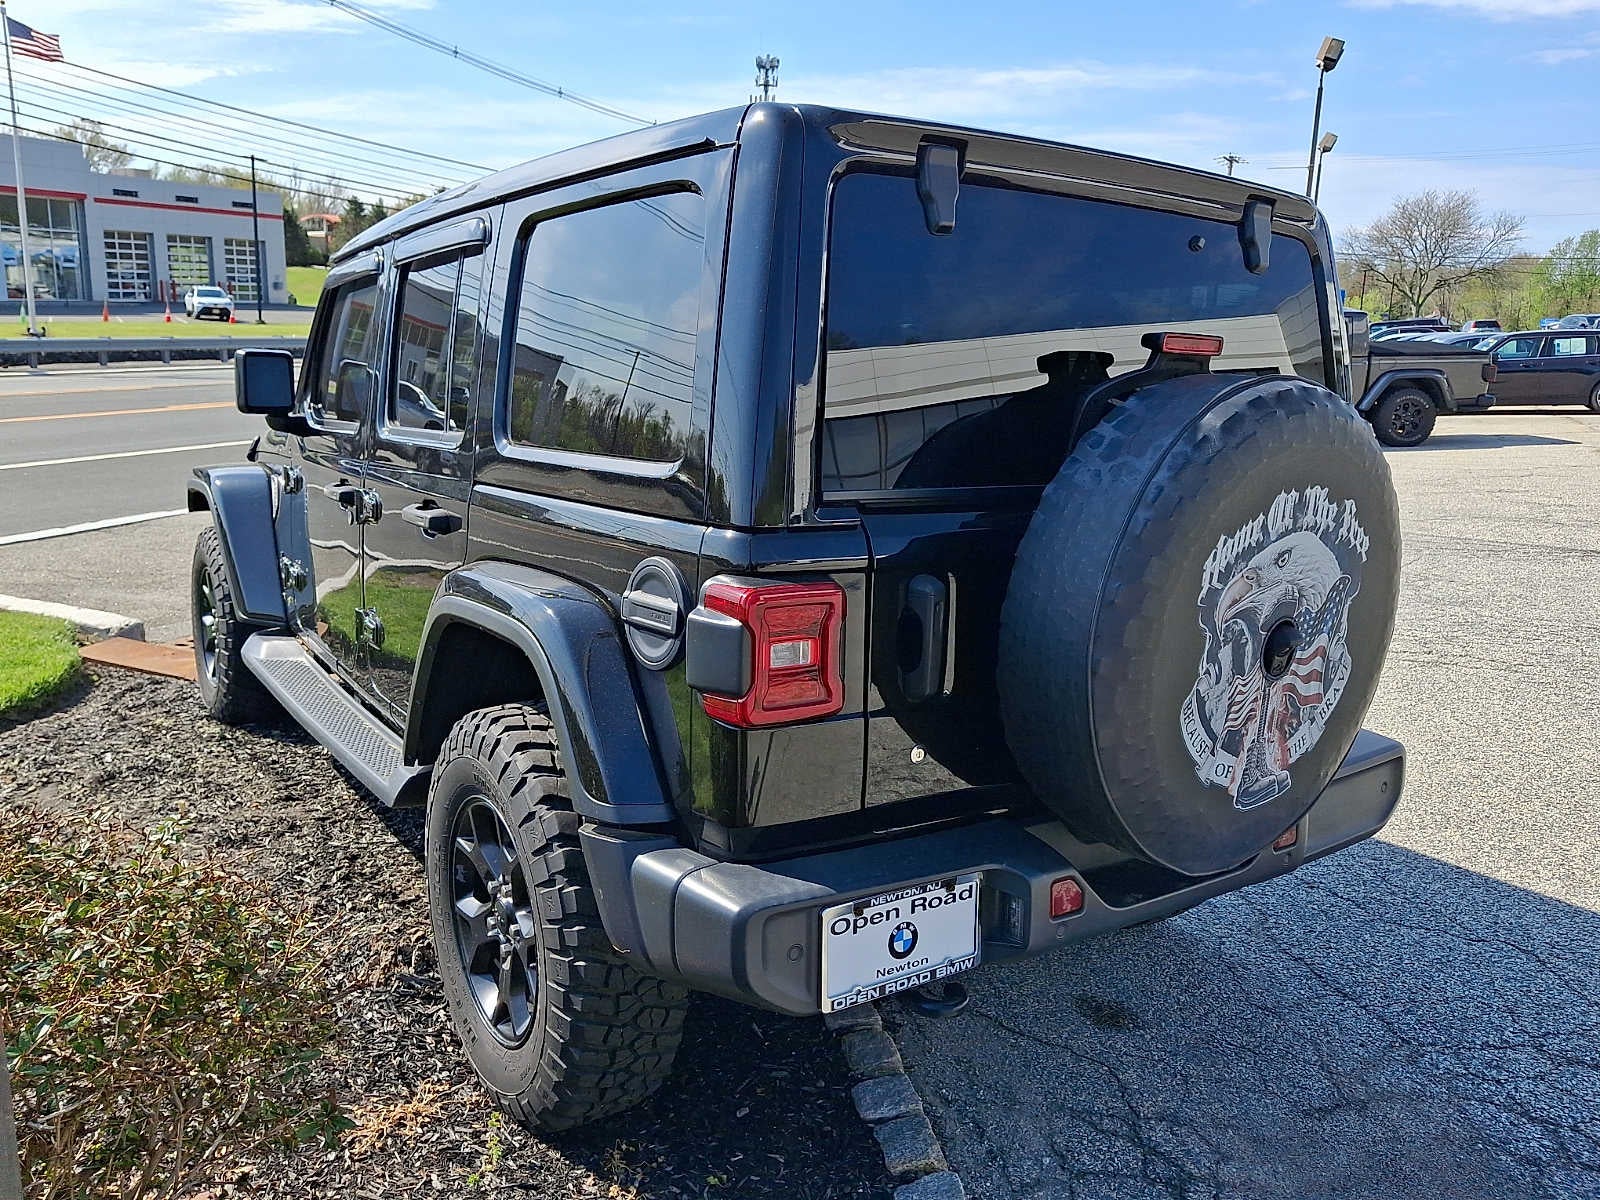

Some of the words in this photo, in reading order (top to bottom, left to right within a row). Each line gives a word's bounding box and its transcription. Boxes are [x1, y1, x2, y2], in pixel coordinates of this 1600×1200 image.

[1182, 697, 1211, 760] BECAUSE
[1214, 763, 1235, 779] OF
[830, 907, 901, 936] Open
[910, 884, 974, 915] Road
[926, 881, 943, 892] NJ
[833, 989, 880, 1010] OPEN
[885, 973, 930, 994] ROAD
[936, 958, 975, 978] BMW
[876, 957, 929, 978] Newton
